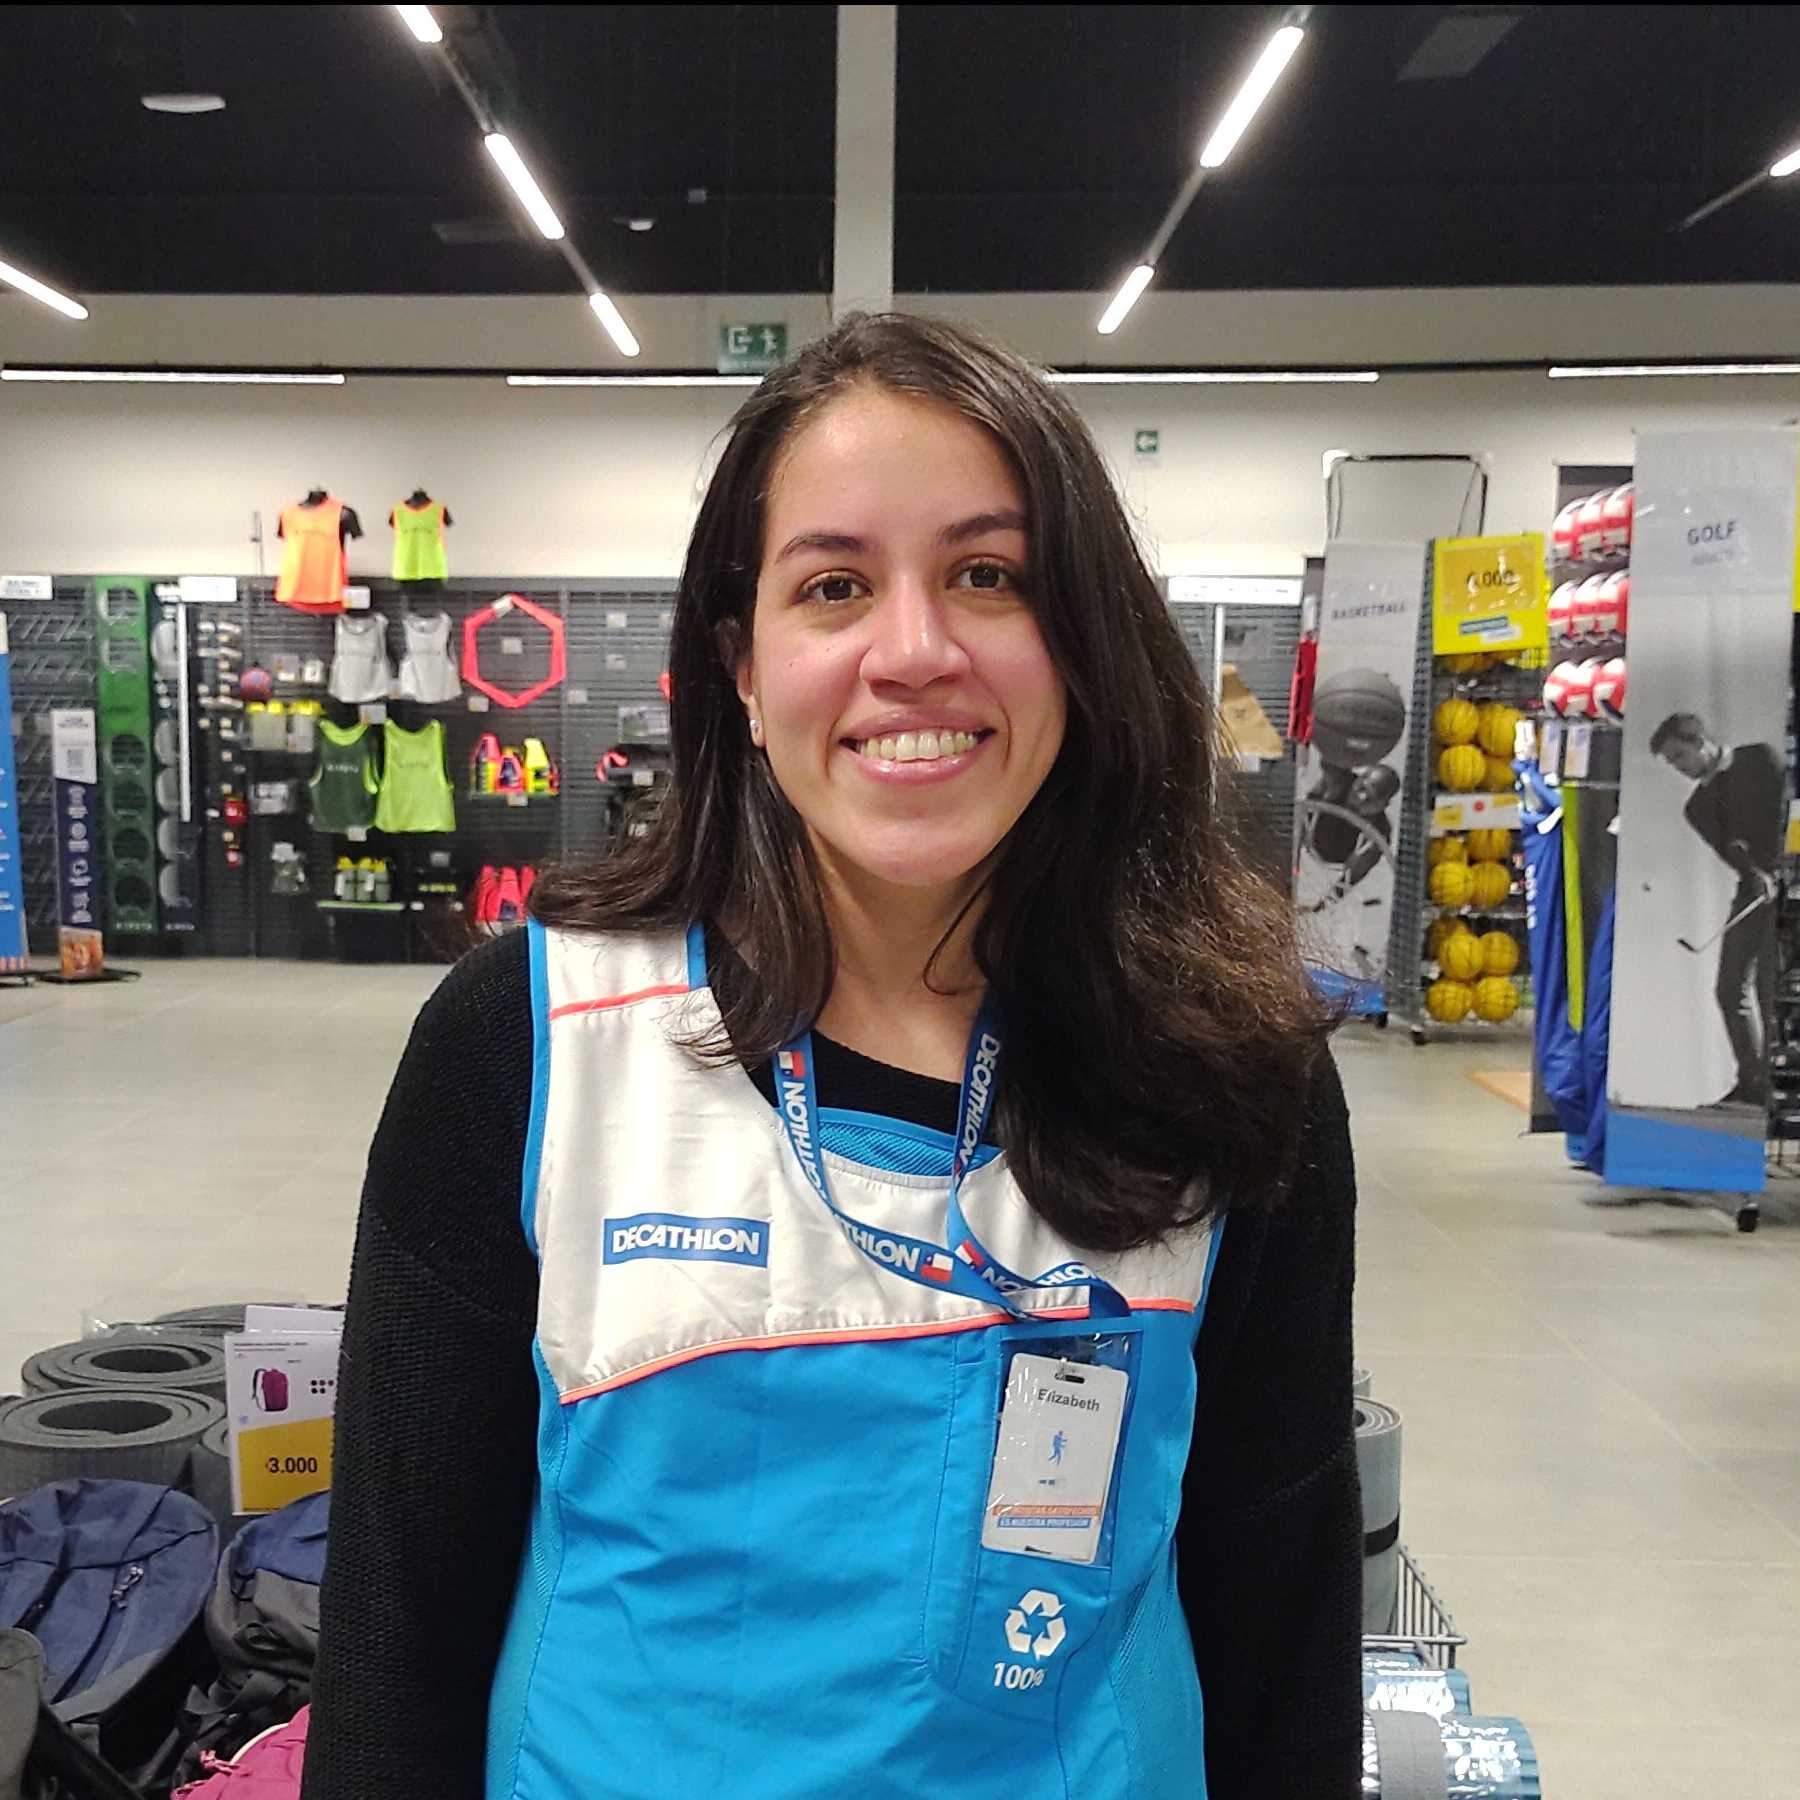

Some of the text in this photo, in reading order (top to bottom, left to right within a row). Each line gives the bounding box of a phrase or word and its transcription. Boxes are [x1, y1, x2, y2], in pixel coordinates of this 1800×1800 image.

[1688, 520, 1736, 545] GOLF
[959, 1033, 1000, 1167] DECATHLON
[612, 1223, 760, 1255] DECATHLON
[1038, 1388, 1100, 1412] Elizabeth
